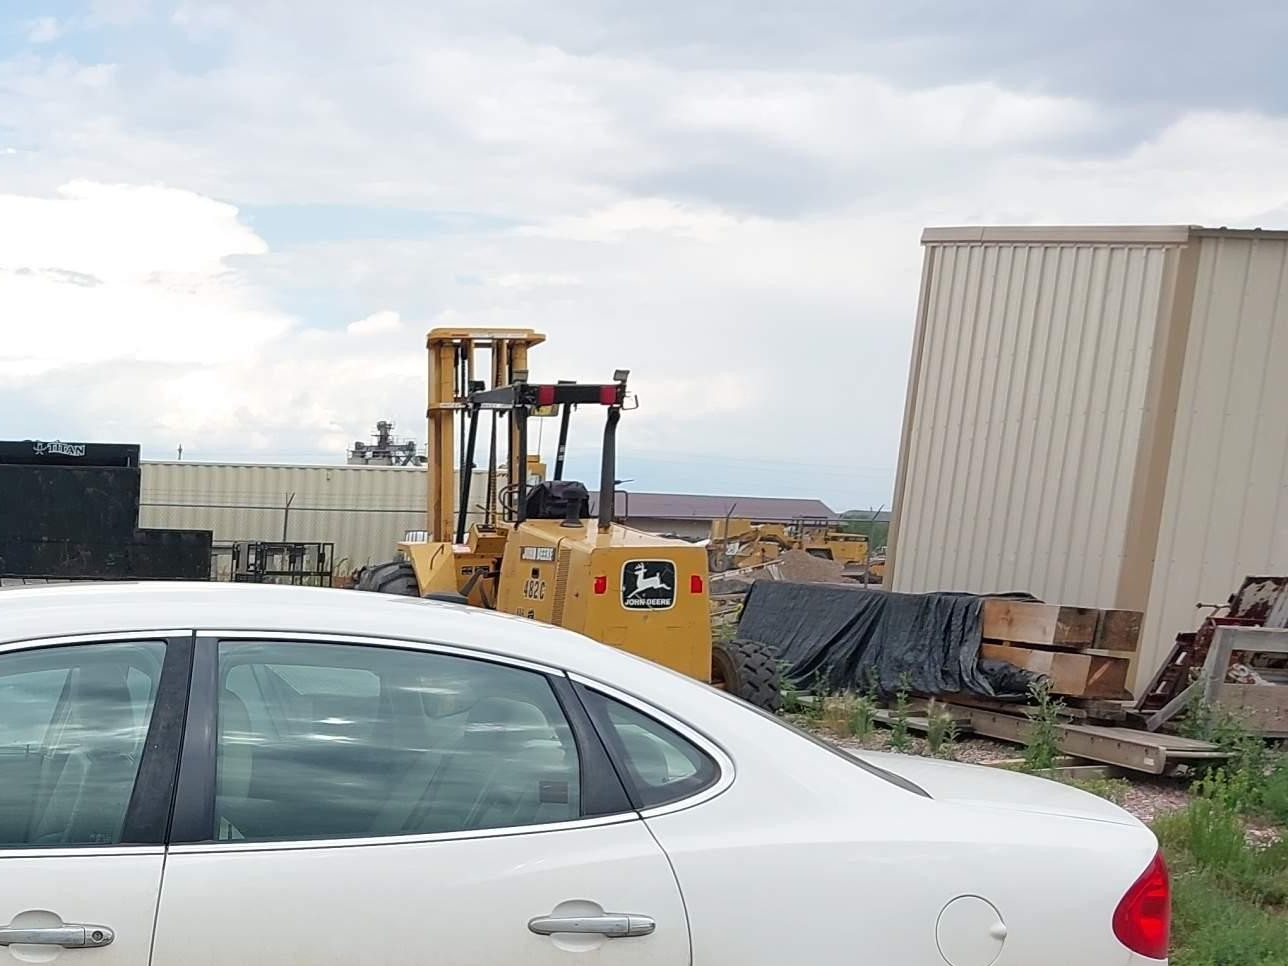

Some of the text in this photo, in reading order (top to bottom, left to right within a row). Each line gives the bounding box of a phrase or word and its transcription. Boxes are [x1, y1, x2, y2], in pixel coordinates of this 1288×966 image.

[47, 442, 86, 457] TITAN
[523, 580, 546, 600] 482C
[624, 598, 672, 606] JOHN DEERE
